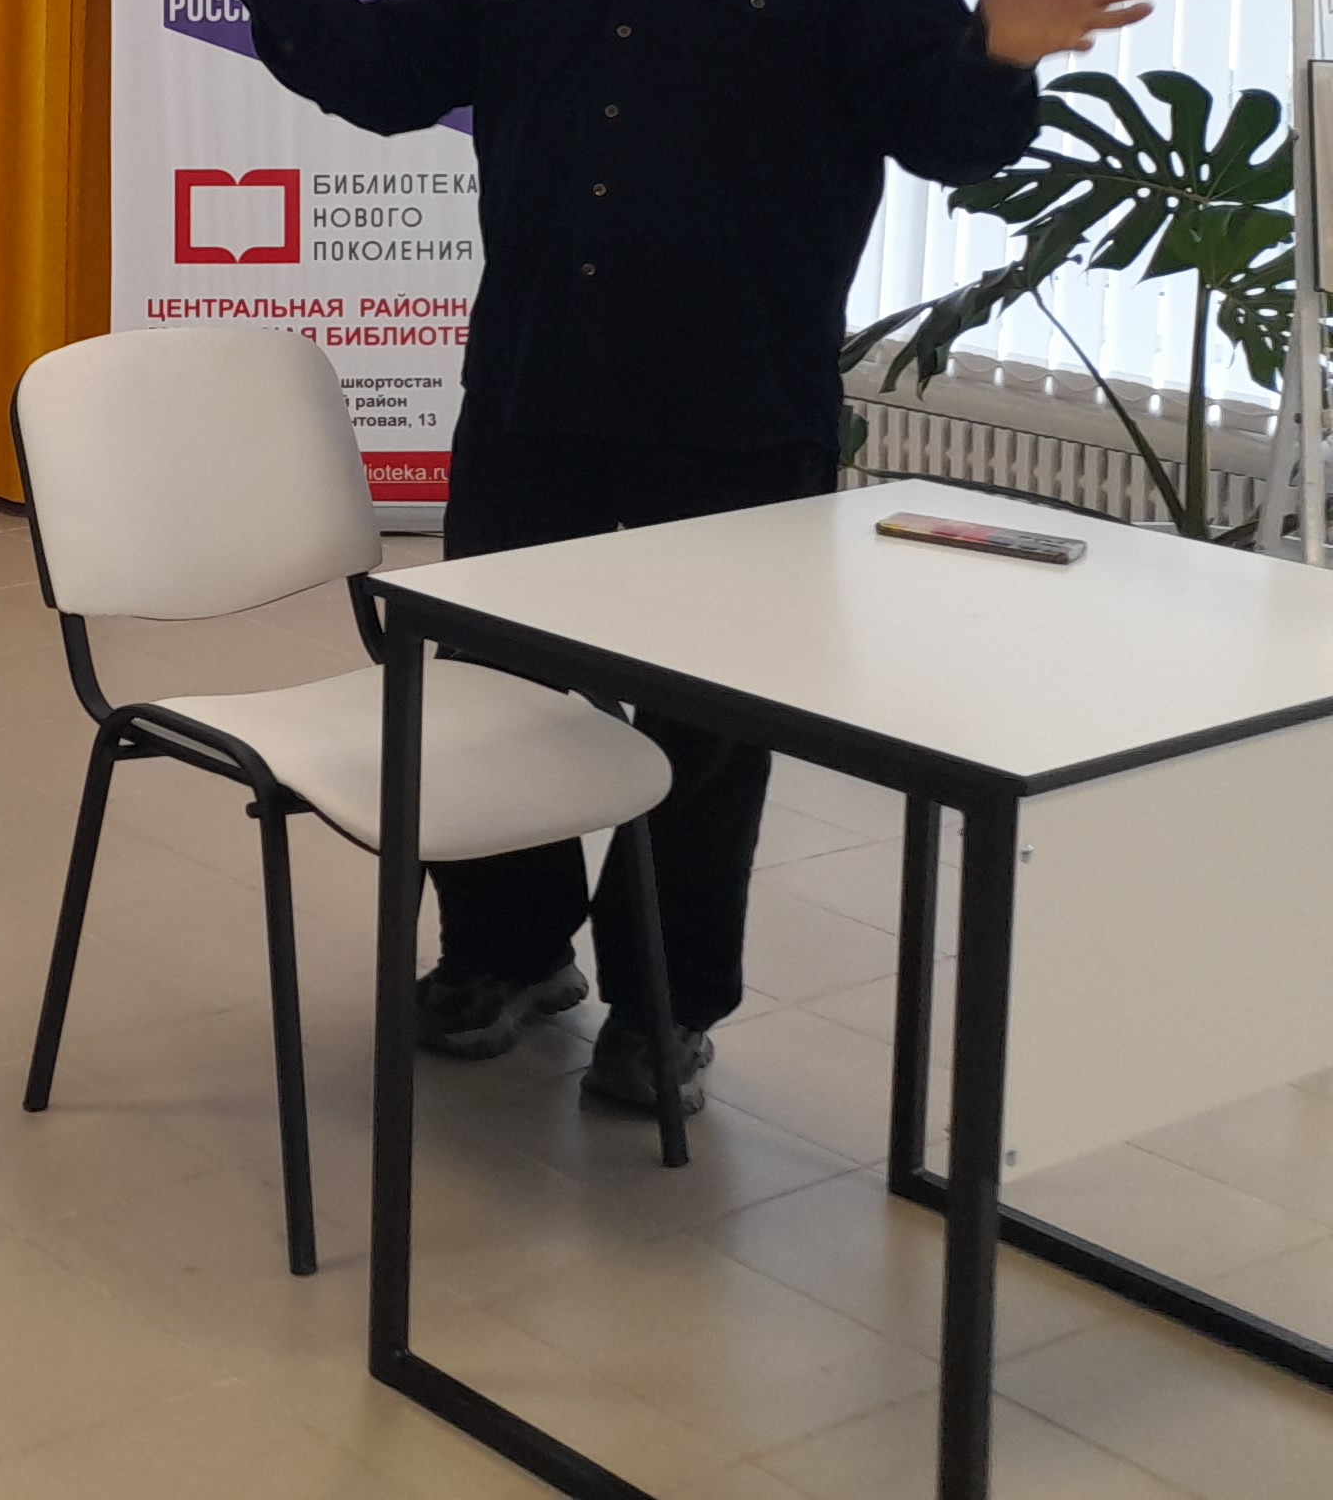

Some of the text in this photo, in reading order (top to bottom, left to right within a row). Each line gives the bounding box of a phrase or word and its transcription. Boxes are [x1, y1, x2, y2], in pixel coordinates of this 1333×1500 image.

[313, 173, 478, 195] БИБЛИОТЕКА
[313, 207, 423, 228] НОВОГО
[313, 240, 473, 261] ПОКОЛЕНИЯ
[147, 293, 469, 322] ЦЕНТРАЛЬНАЯ РАЙОНН
[327, 326, 470, 346] БИБЛИОТЕ
[341, 377, 443, 391] шкортостан
[355, 394, 408, 411] район
[418, 413, 437, 427] 13
